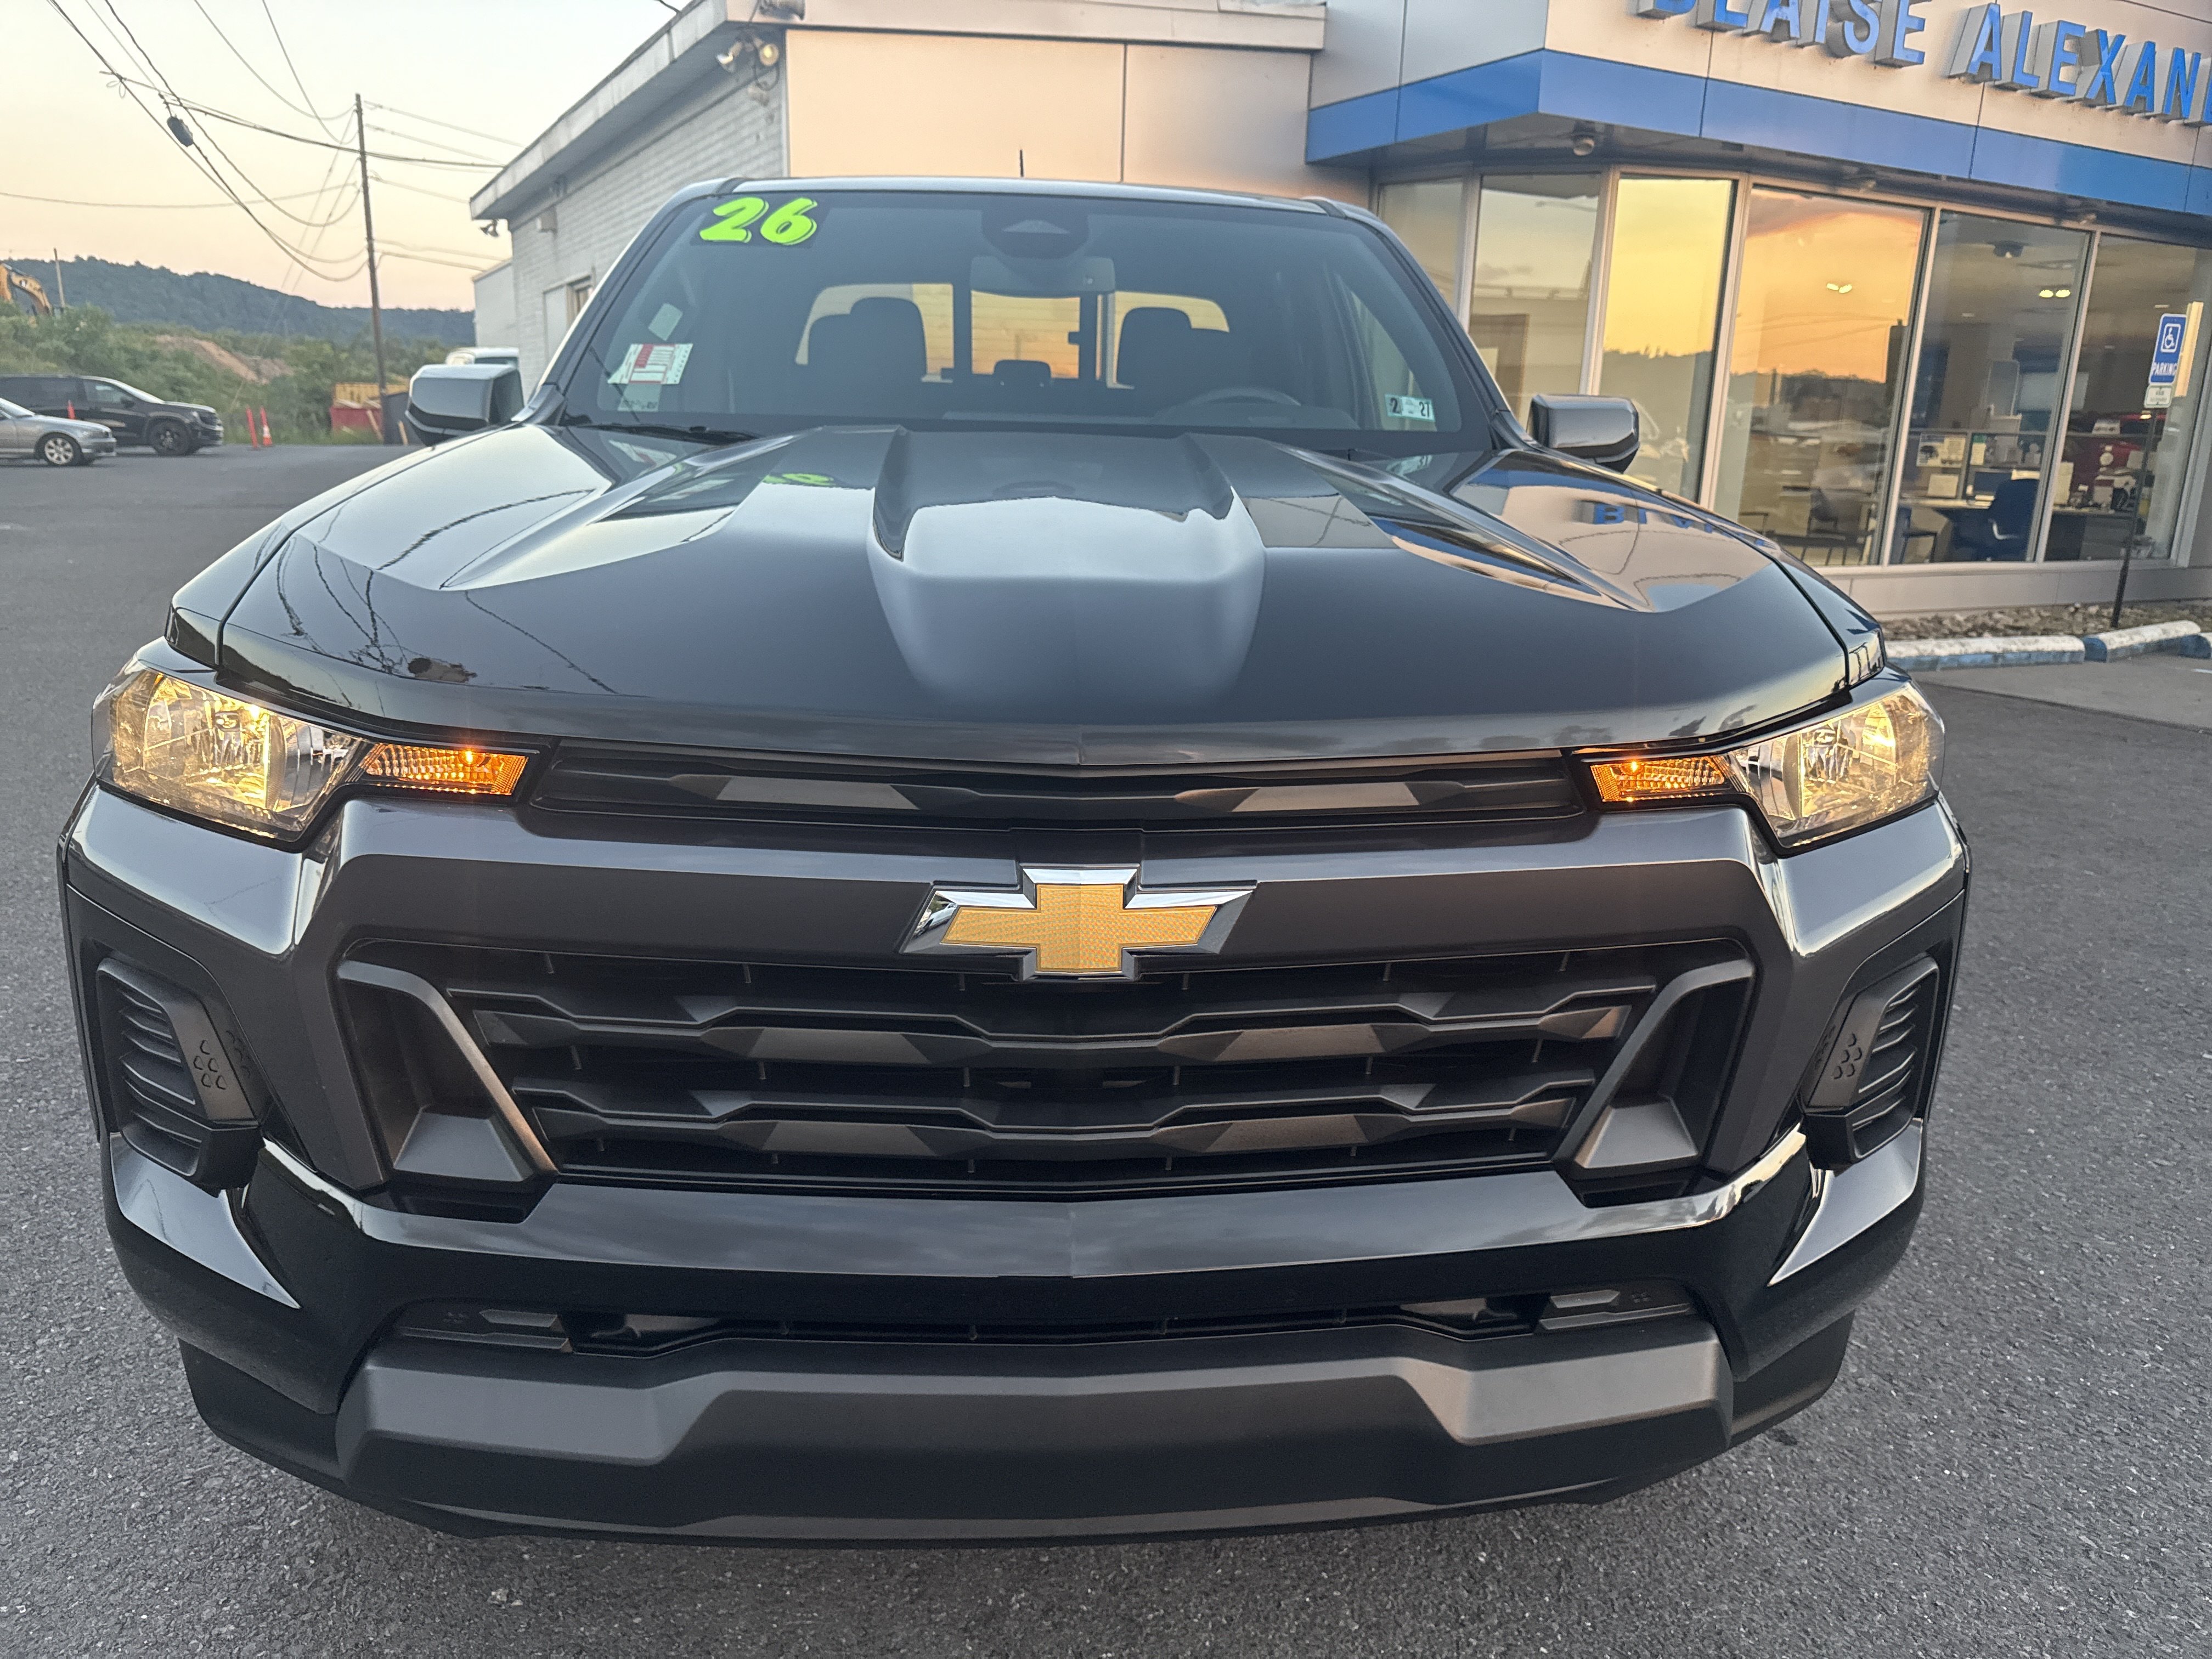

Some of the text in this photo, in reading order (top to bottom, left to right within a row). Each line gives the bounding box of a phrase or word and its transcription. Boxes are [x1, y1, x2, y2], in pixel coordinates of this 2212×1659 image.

[1651, 0, 1926, 65] LAISE
[699, 197, 817, 245] 26
[2151, 362, 2178, 376] PARKING
